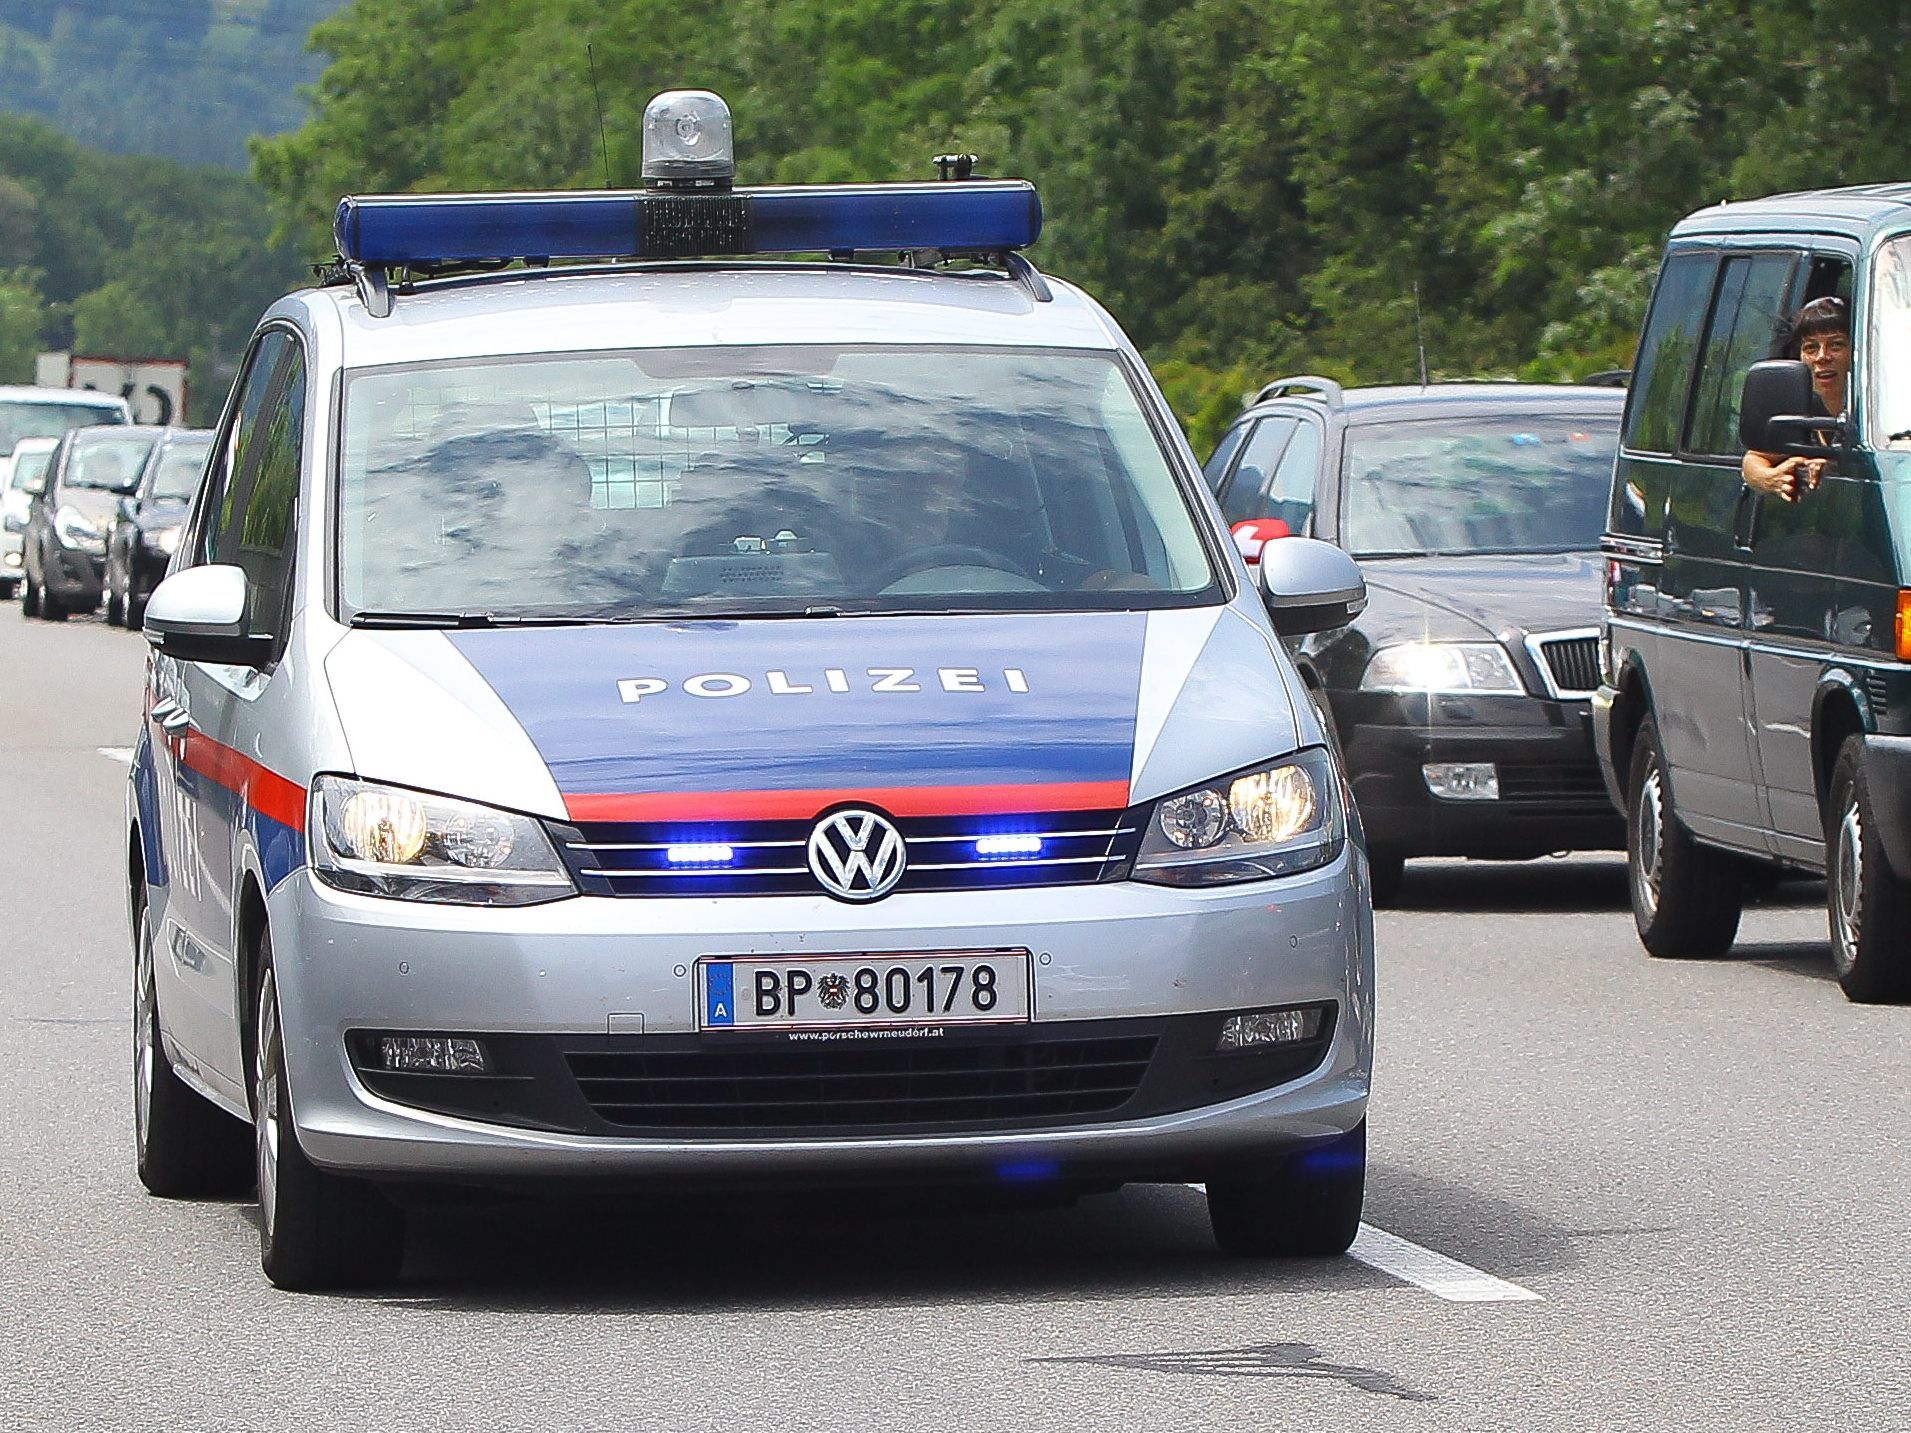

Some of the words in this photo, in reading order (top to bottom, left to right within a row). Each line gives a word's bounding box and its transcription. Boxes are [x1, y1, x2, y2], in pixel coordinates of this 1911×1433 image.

[616, 667, 1030, 704] POLIZEI
[812, 809, 904, 899] VW
[714, 1003, 727, 1018] A
[755, 969, 813, 1017] BP
[854, 964, 998, 1015] 80178
